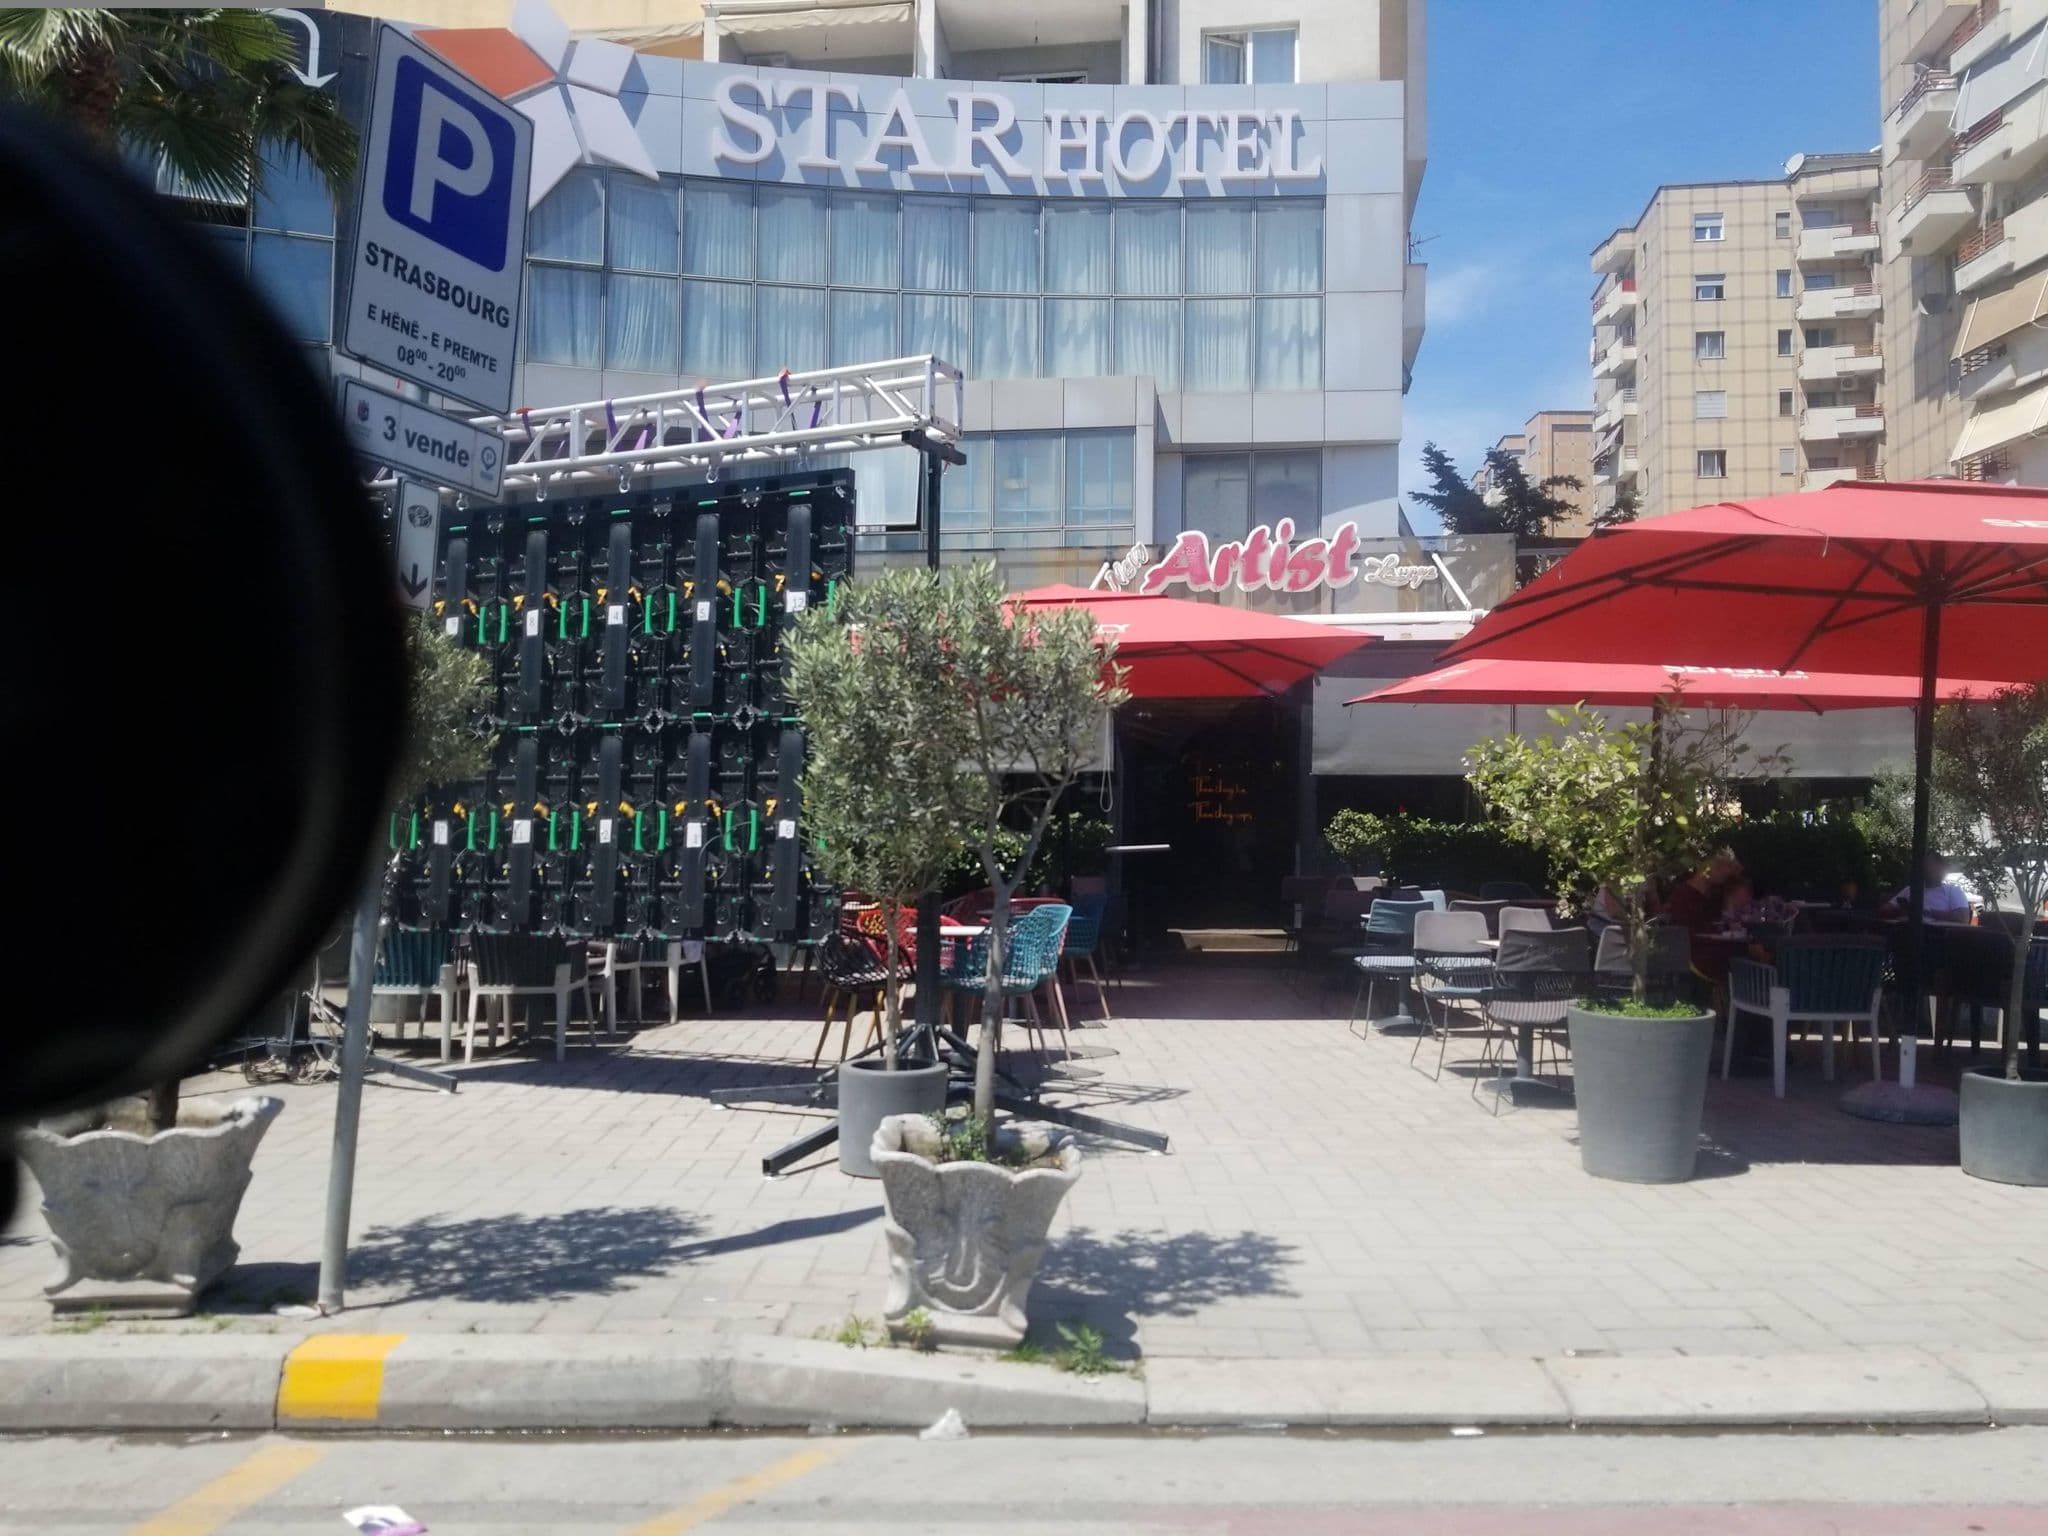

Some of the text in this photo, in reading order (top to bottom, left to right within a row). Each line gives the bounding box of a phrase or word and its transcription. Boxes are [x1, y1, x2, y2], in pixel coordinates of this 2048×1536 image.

[409, 82, 494, 224] P
[712, 74, 1322, 182] STAR HOTEL
[365, 241, 511, 329] STRASBOURG
[367, 303, 377, 321] E
[380, 308, 420, 340] HËNË
[431, 331, 440, 348] E
[443, 338, 498, 373] PREMTE
[382, 415, 397, 441] 3
[404, 427, 471, 468] vende
[1140, 517, 1362, 594] Artist
